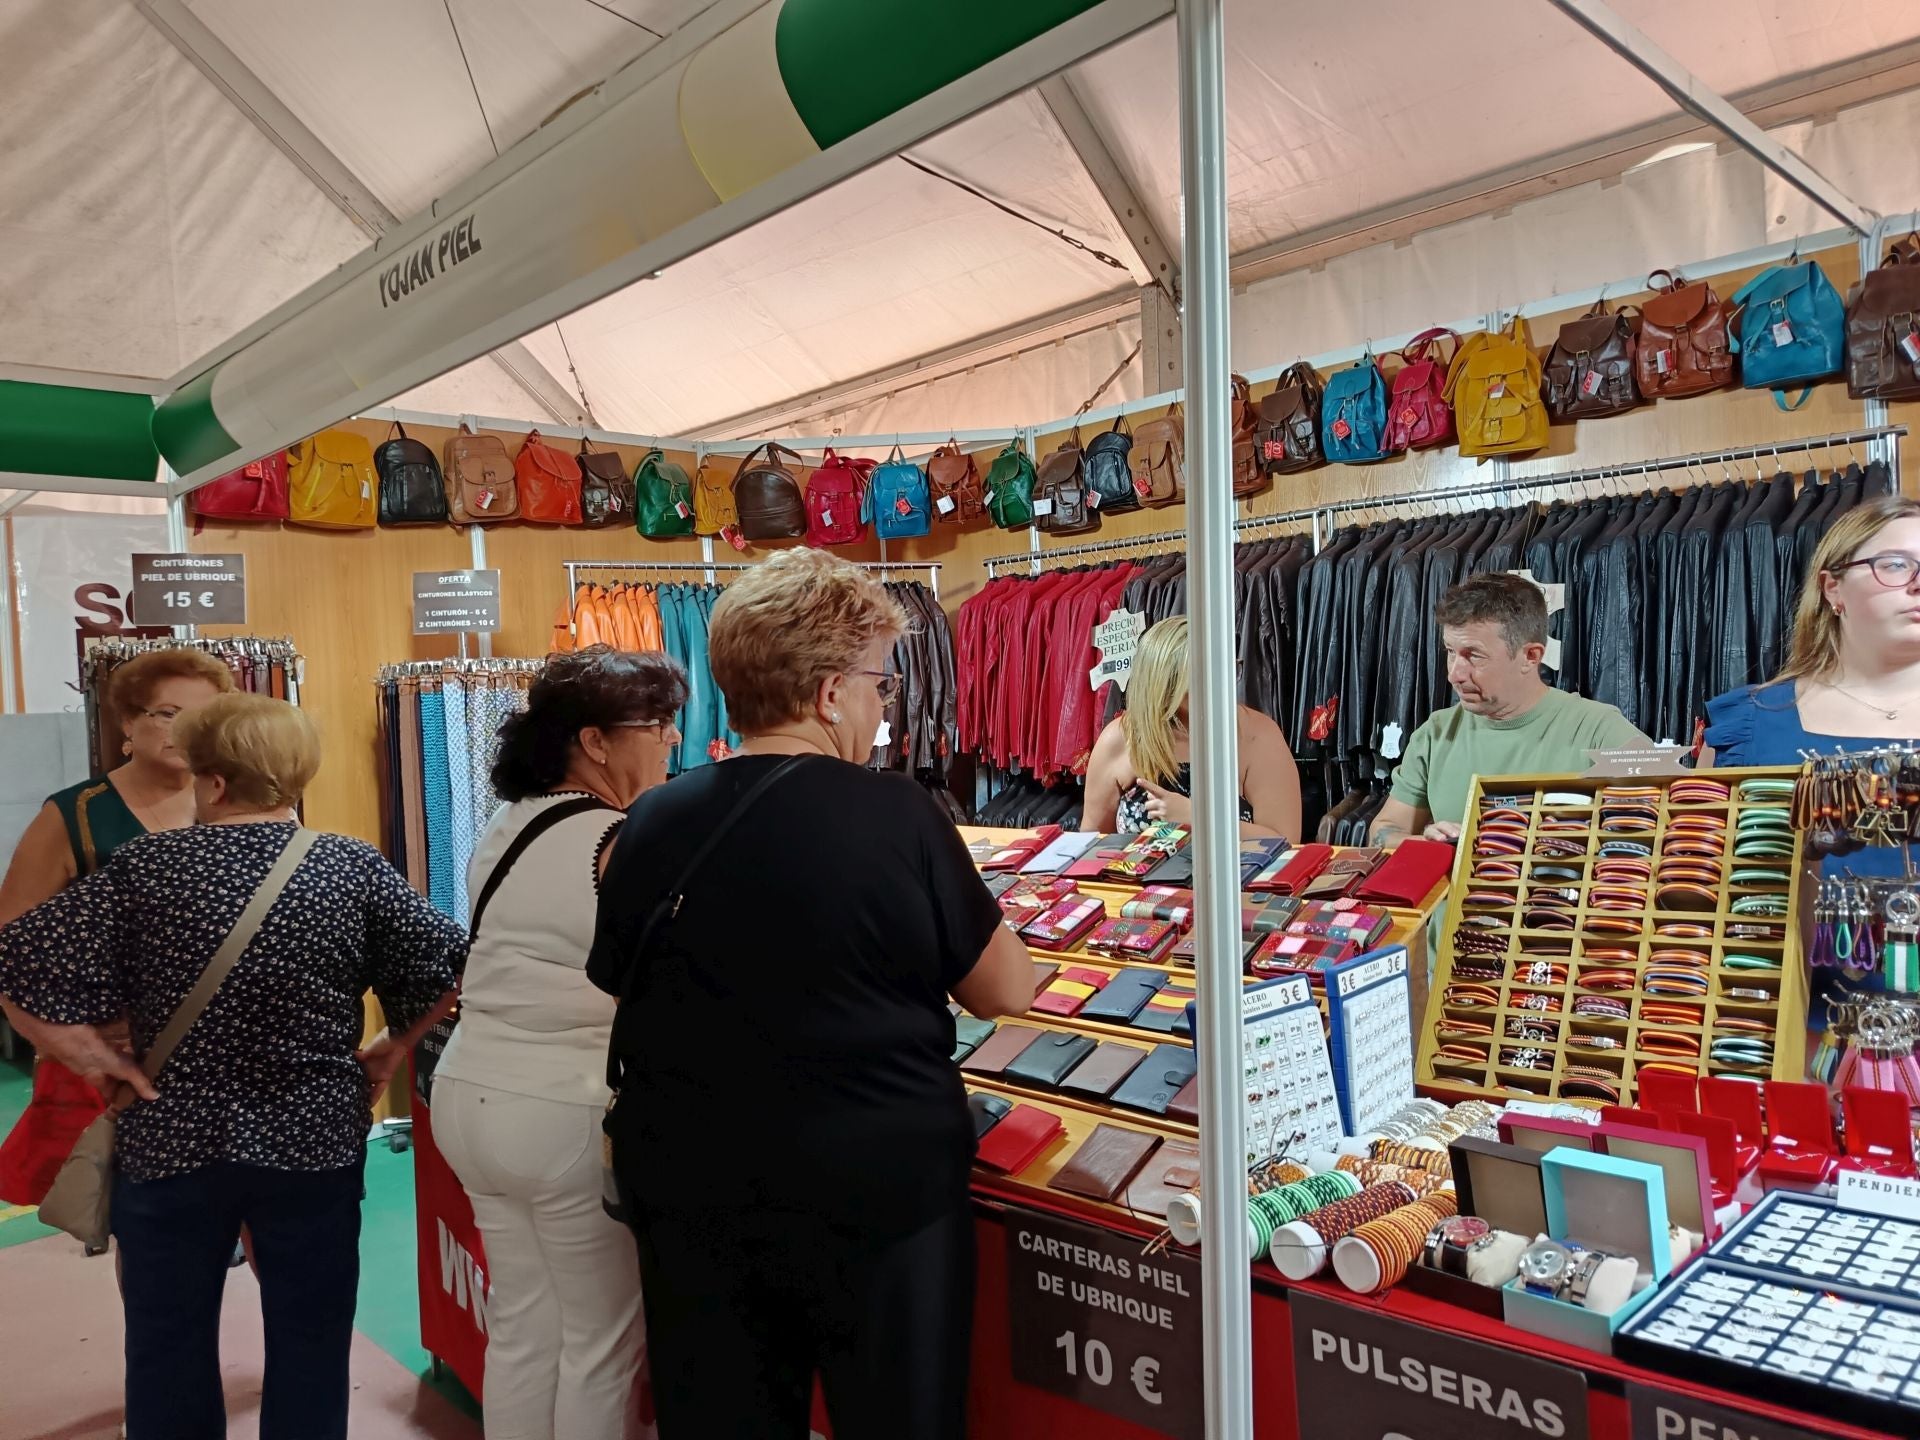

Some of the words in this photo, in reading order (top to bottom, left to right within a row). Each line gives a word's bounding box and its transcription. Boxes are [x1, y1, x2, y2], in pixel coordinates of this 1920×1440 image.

[379, 240, 435, 308] YOJAN
[438, 214, 482, 272] PIEL
[152, 559, 224, 567] CINTURONES
[141, 573, 165, 582] PIEL
[167, 573, 181, 581] DE
[184, 573, 236, 582] UBRIQUE
[438, 575, 472, 584] OFERTA
[162, 591, 192, 608] 15
[198, 591, 215, 608] €
[418, 591, 456, 599] CINTURONES
[431, 608, 468, 617] CINTURÓN
[1102, 616, 1136, 634] PRECIO
[1104, 640, 1136, 656] FERIA
[1628, 767, 1633, 775] 5
[1635, 767, 1641, 775] €
[1341, 976, 1348, 993] 3
[1349, 973, 1356, 990] €
[1387, 957, 1393, 974] 3
[1394, 955, 1400, 971] €
[1280, 987, 1290, 1005] 3
[1291, 984, 1302, 1002] €
[424, 1040, 434, 1052] DE
[1018, 1230, 1131, 1279] CARTERAS
[1138, 1263, 1190, 1298] PIEL
[1037, 1271, 1065, 1296] DE
[1071, 1281, 1174, 1330] UBRIQUE
[1056, 1330, 1113, 1386] 10
[1130, 1355, 1163, 1405] €
[1311, 1328, 1566, 1438] PULSERAS
